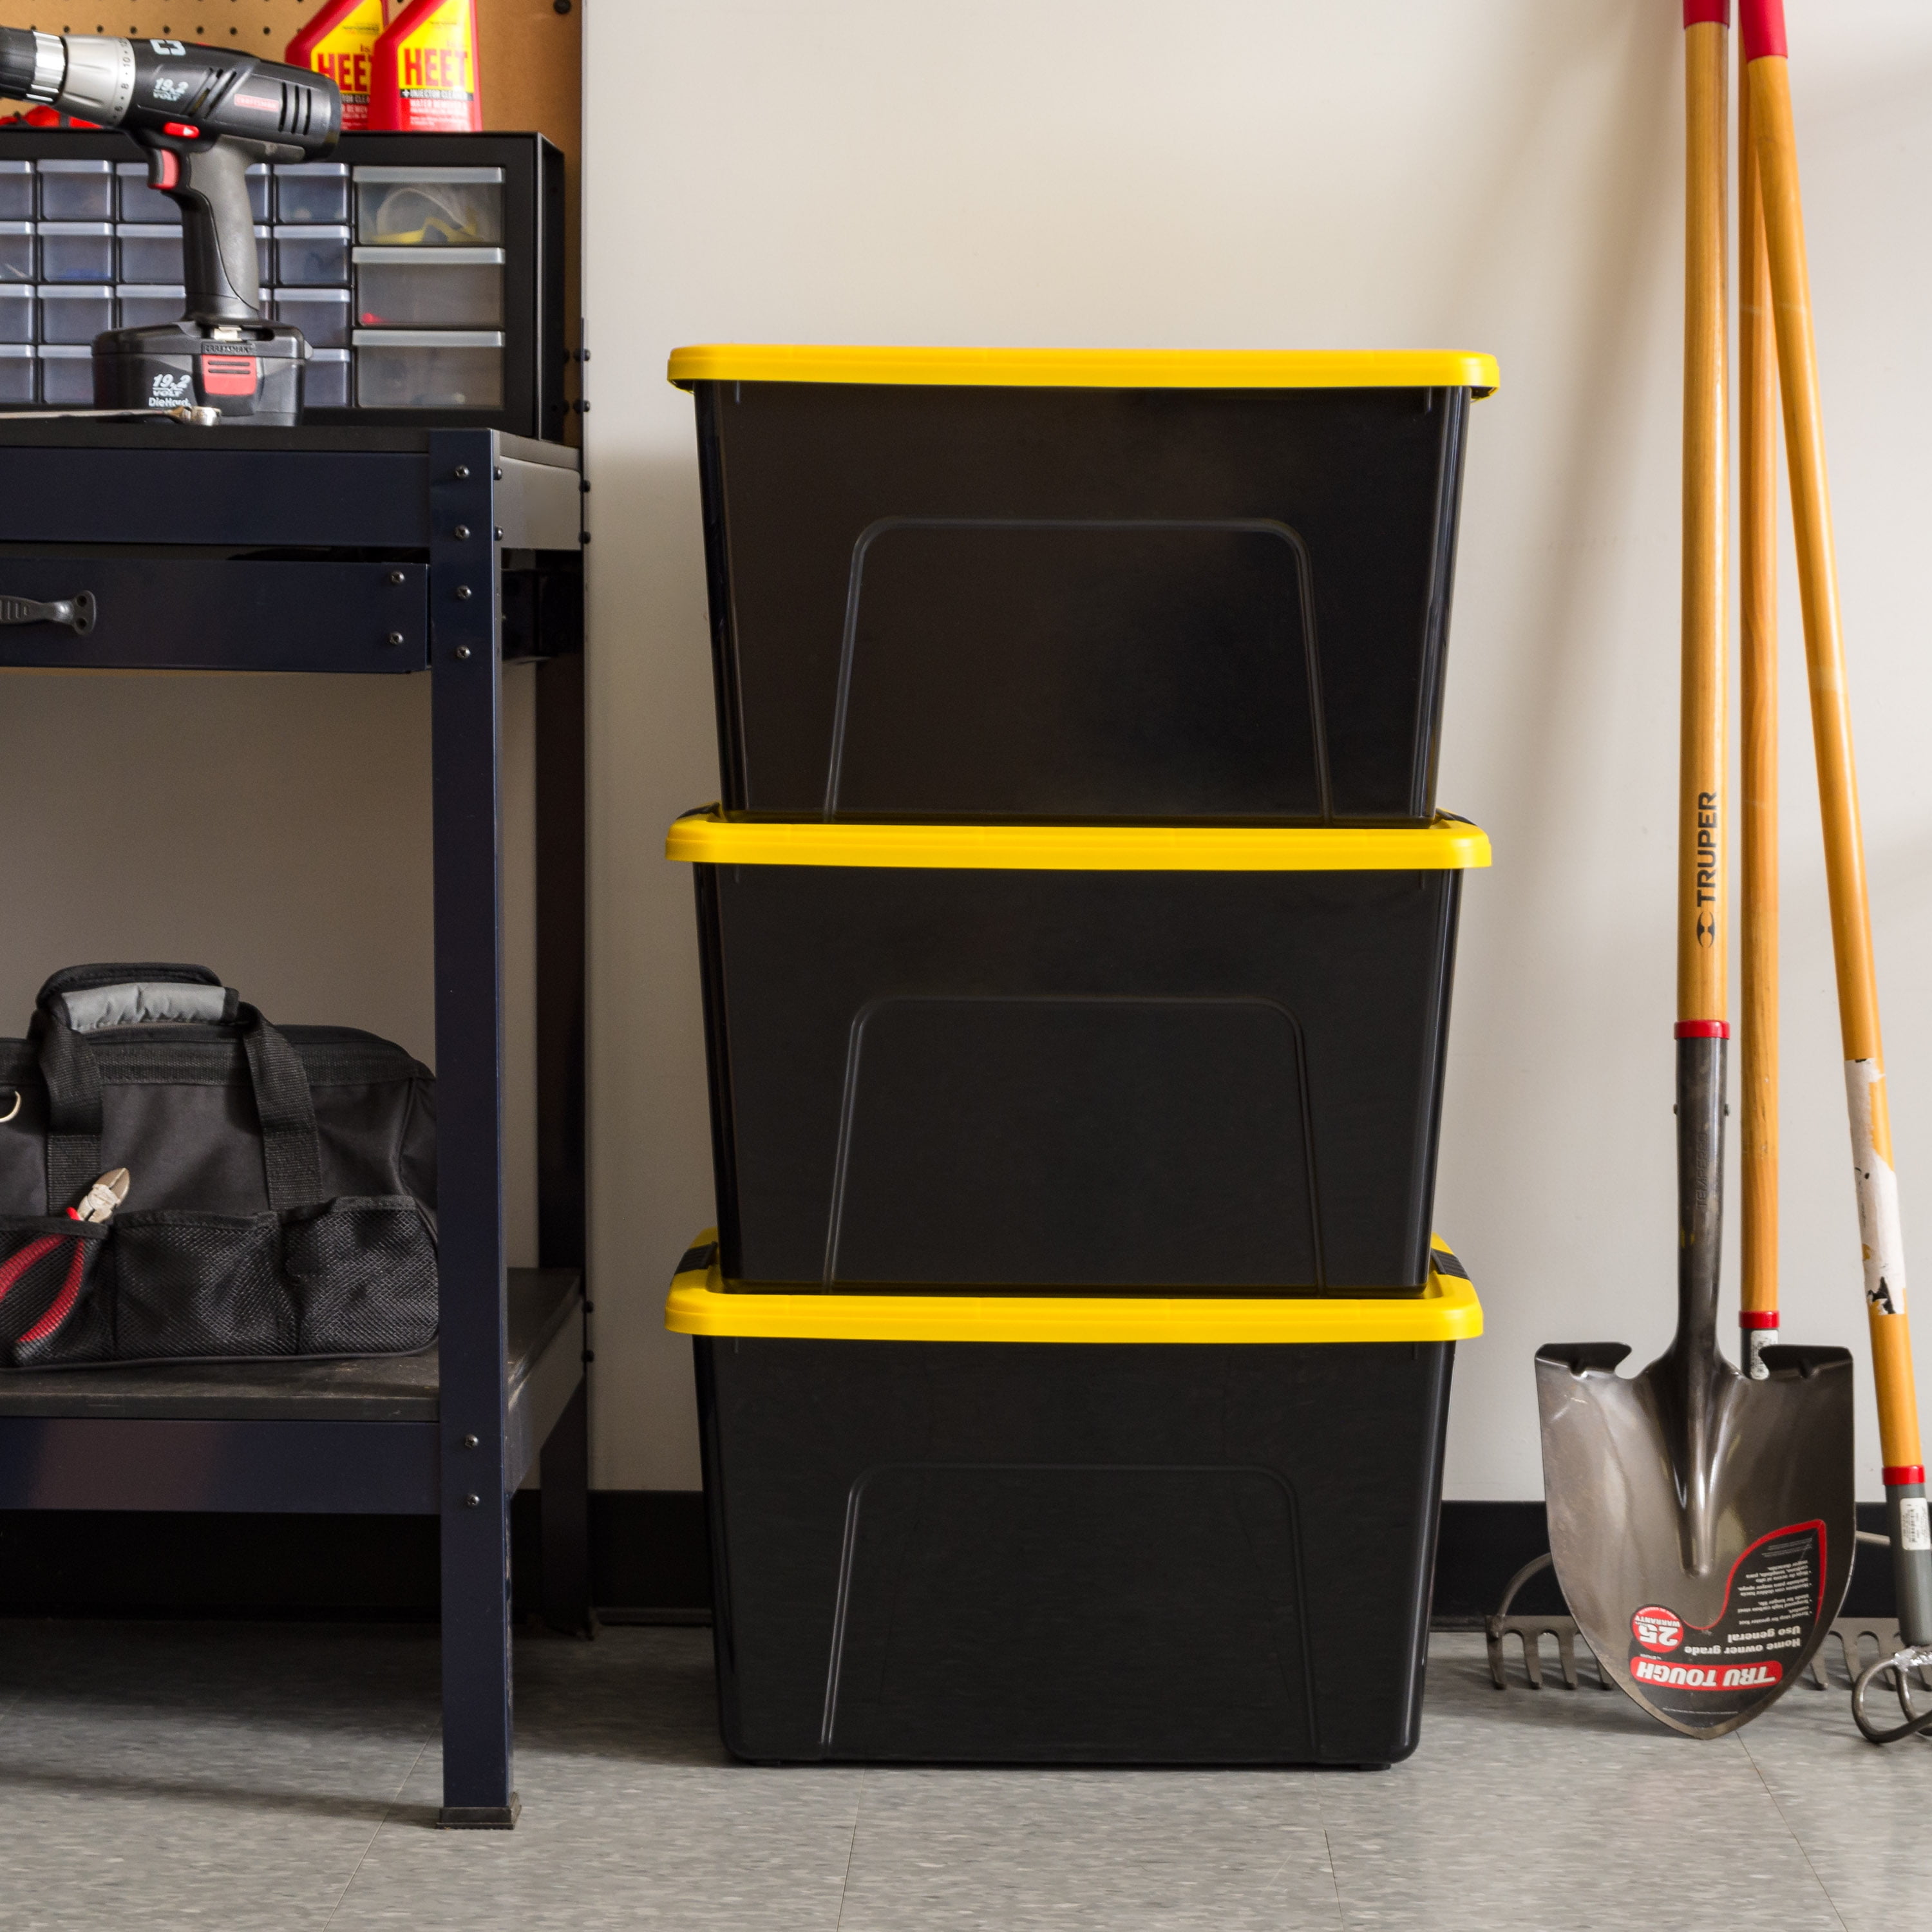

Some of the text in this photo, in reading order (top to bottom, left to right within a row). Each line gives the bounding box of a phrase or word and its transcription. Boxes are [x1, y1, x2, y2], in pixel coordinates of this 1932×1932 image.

[122, 56, 131, 67] 10
[404, 48, 468, 88] HEET
[317, 53, 371, 91] HEE
[155, 77, 189, 95] 19.2
[204, 344, 251, 354] CRAFTSMAN
[153, 374, 192, 389] 19.2
[1696, 791, 1718, 907] TRUPER
[1634, 1615, 1680, 1627] WARRANTY
[1638, 1624, 1678, 1646] 25
[1727, 1625, 1801, 1642] Uso general
[1684, 1638, 1801, 1655] Home owner grade
[1636, 1661, 1776, 1687] TRU TOUGH
